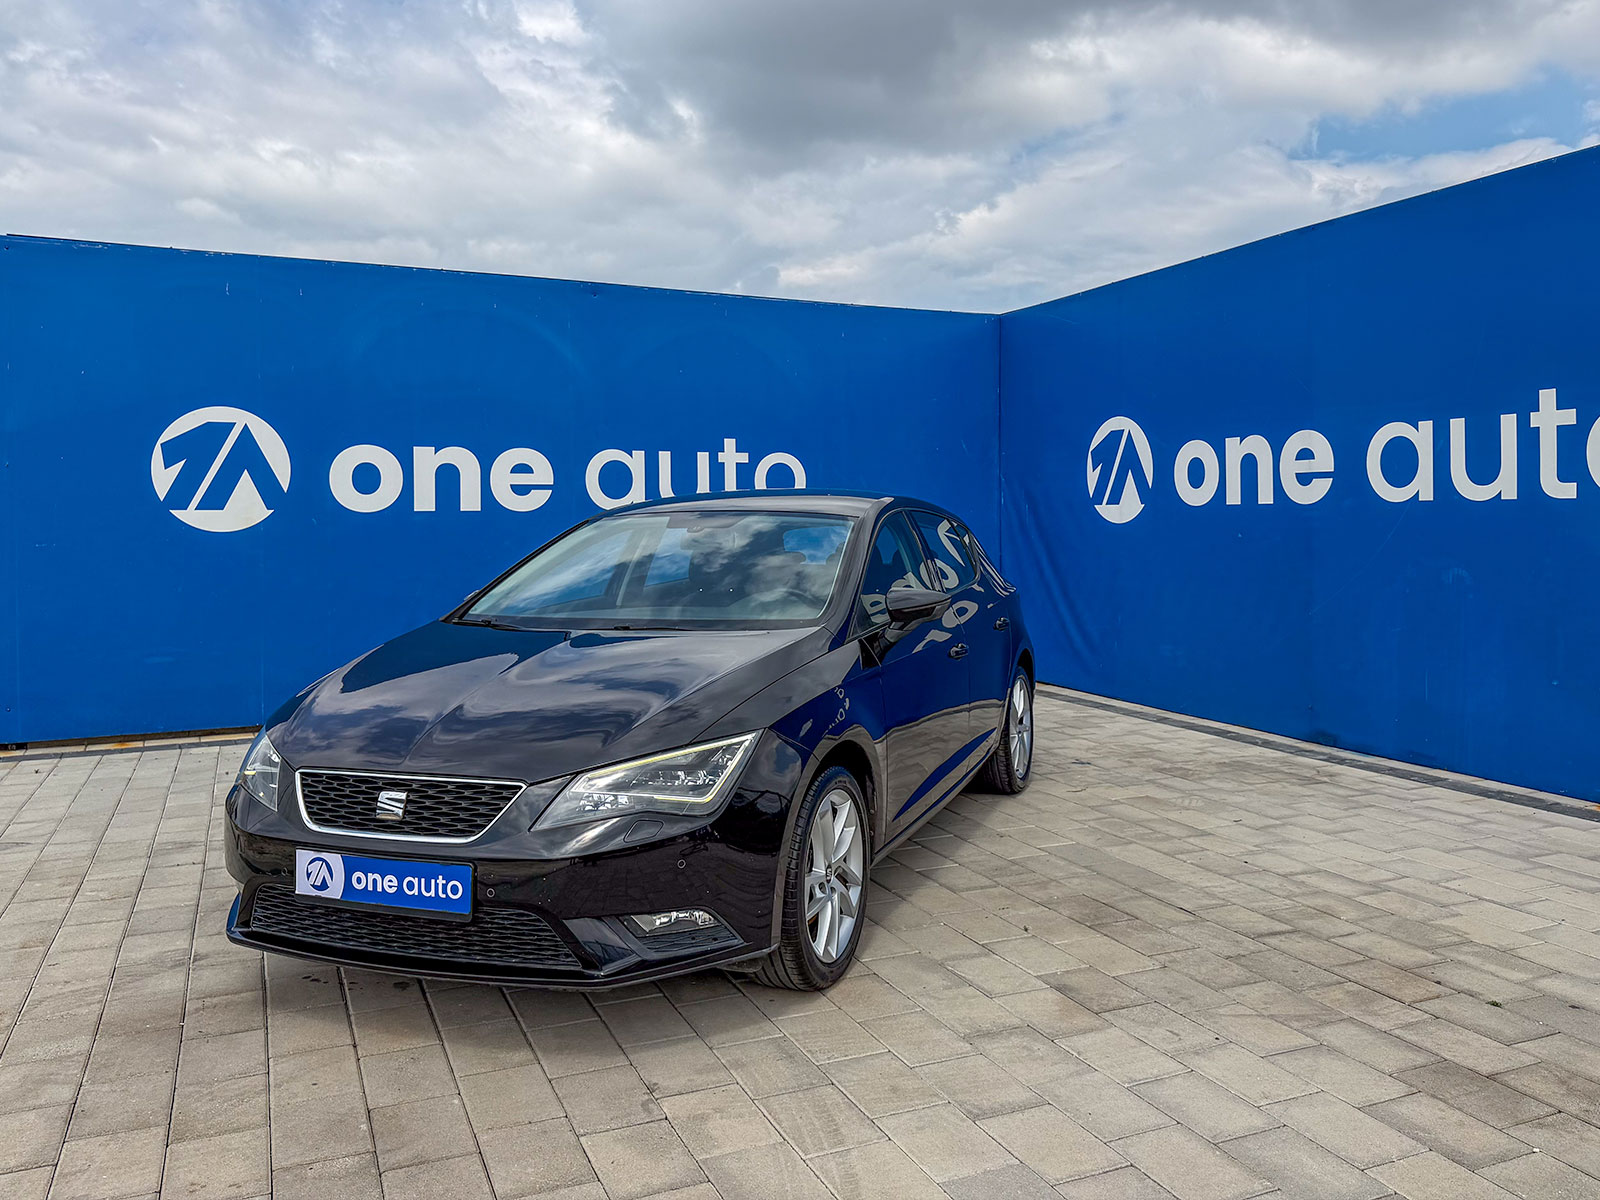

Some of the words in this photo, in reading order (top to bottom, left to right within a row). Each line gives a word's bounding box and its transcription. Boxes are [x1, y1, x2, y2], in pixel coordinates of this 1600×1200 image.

[328, 444, 554, 513] one
[585, 438, 807, 511] auto
[1173, 429, 1335, 507] one
[1366, 388, 1600, 503] aut
[351, 871, 399, 894] one
[402, 875, 463, 900] auto
